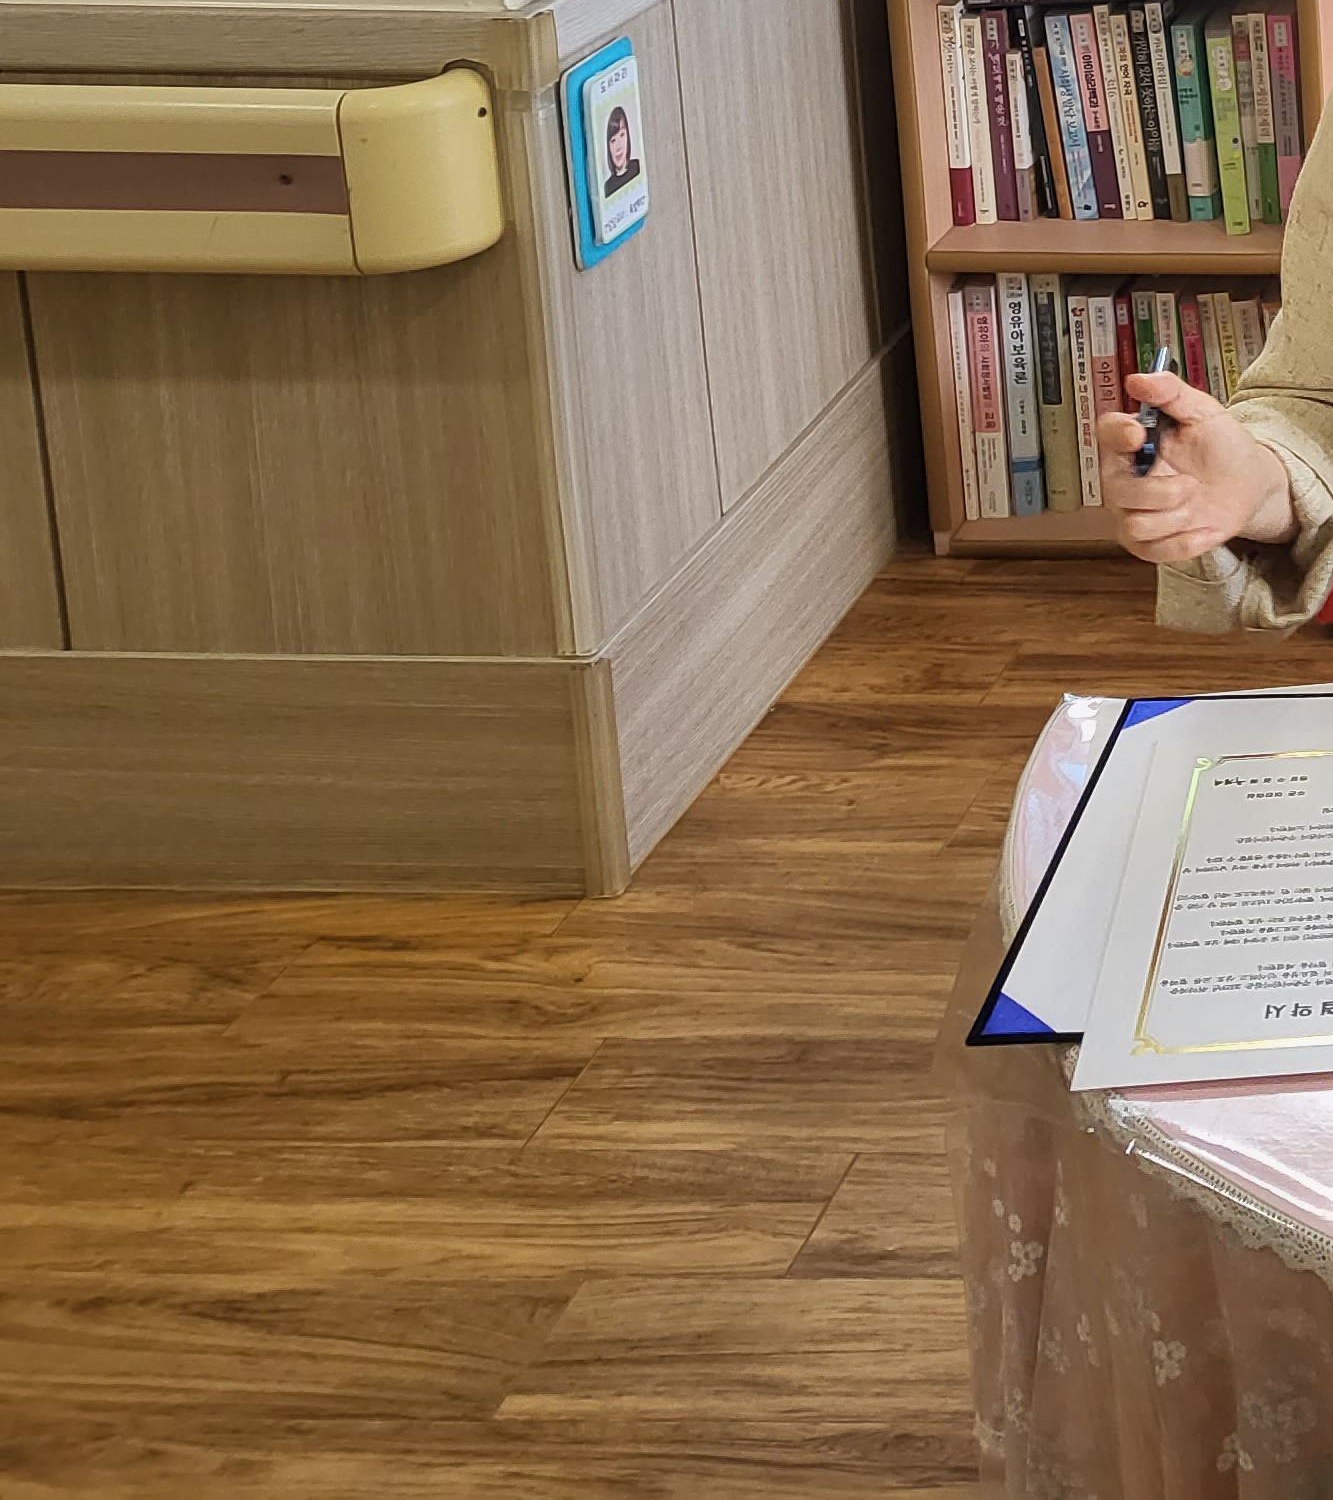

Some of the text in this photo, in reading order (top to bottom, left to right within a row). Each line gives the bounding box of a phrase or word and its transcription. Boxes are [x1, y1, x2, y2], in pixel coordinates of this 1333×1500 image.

[1082, 55, 1099, 108] 아이심리백과
[1139, 67, 1152, 86] 있지
[1066, 120, 1081, 147] 보고서
[1009, 301, 1028, 385] 영유아보육론
